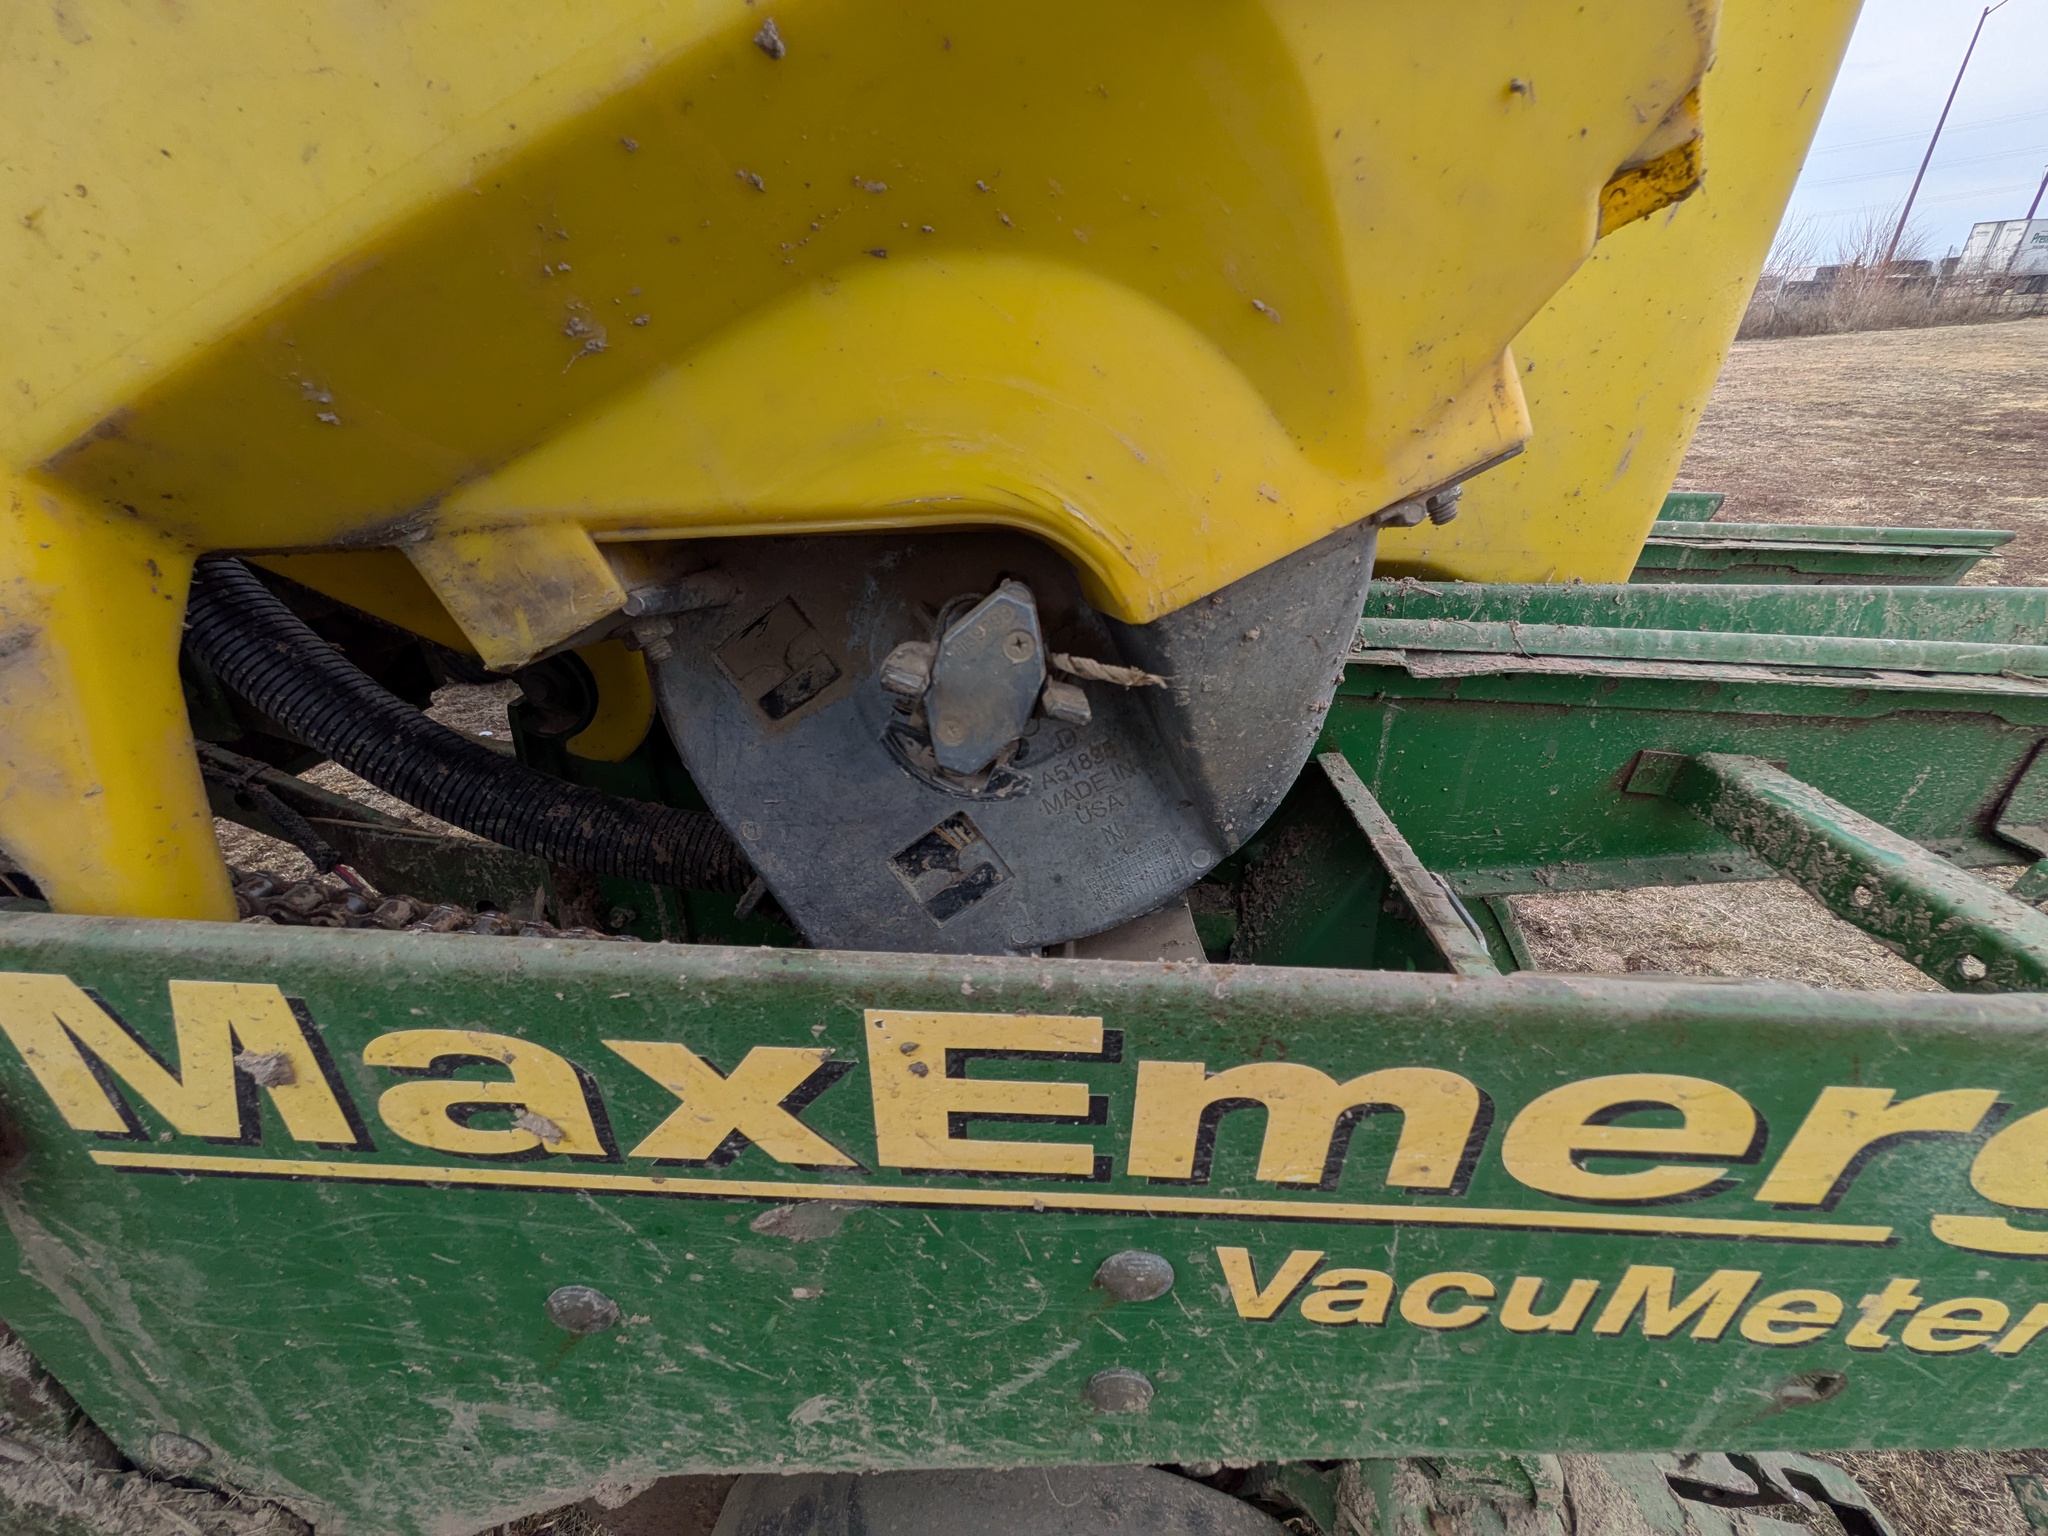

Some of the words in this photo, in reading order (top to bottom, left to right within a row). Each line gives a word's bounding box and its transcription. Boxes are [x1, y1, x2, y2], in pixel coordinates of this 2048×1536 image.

[1042, 773, 1111, 815] MADE
[1110, 759, 1137, 783] IN
[1075, 794, 1125, 824] USA
[1215, 1246, 2048, 1354] VacuMeter
